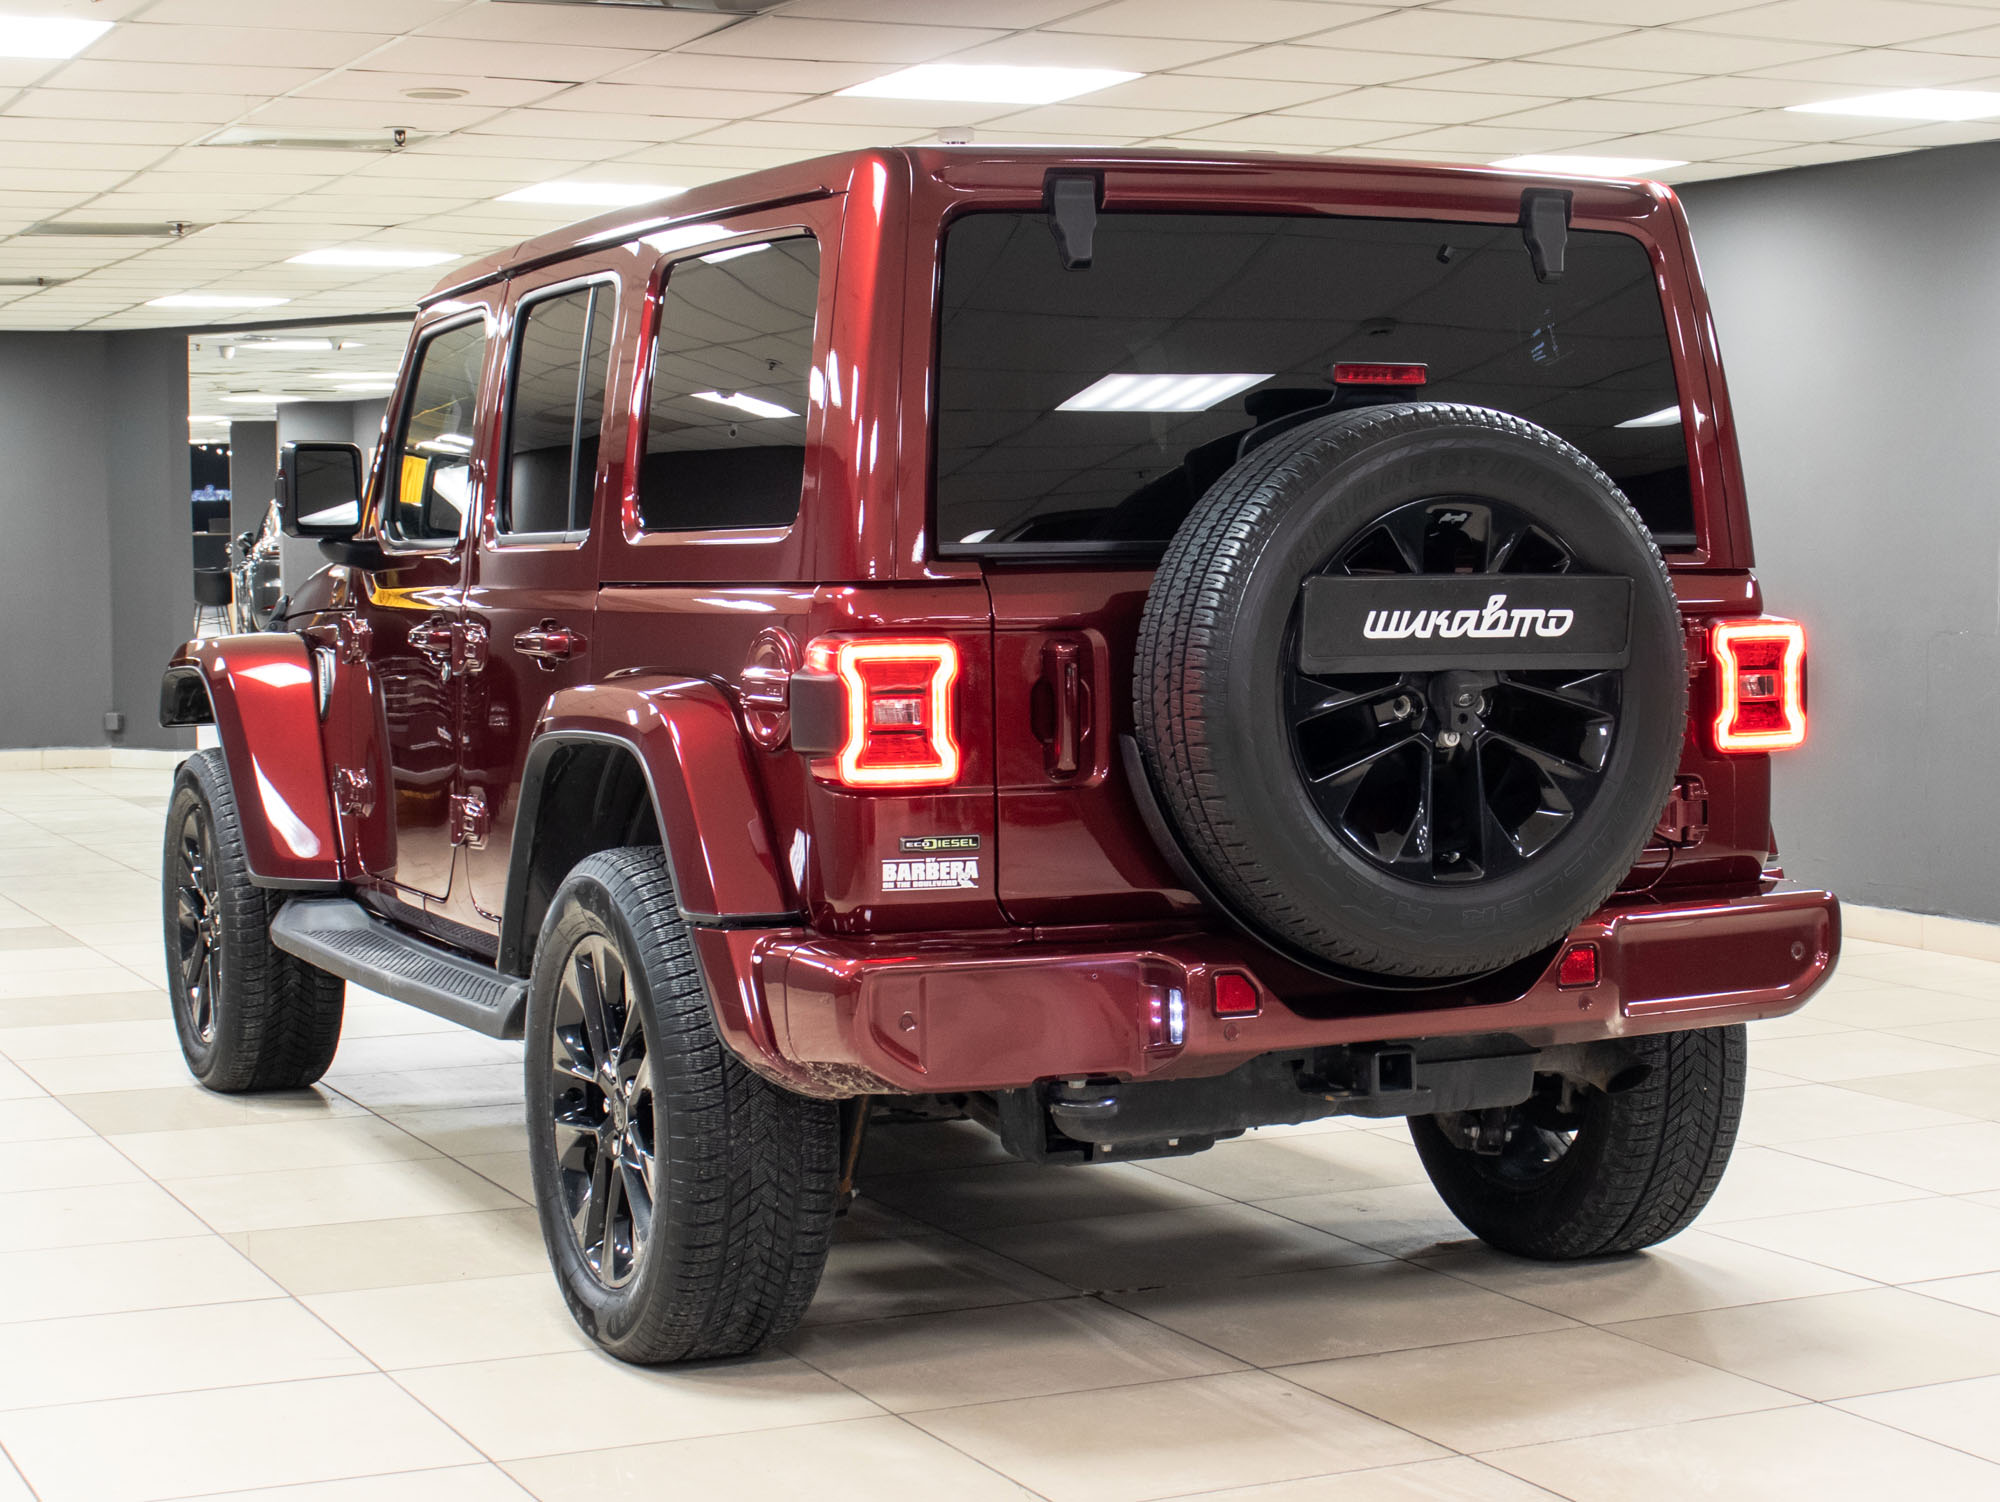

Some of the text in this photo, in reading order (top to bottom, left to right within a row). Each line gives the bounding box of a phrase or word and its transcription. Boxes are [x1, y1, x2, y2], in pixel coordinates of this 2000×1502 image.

[1363, 594, 1574, 639] шикавто
[905, 838, 977, 849] ECODIESEL
[882, 861, 979, 882] BARBERA
